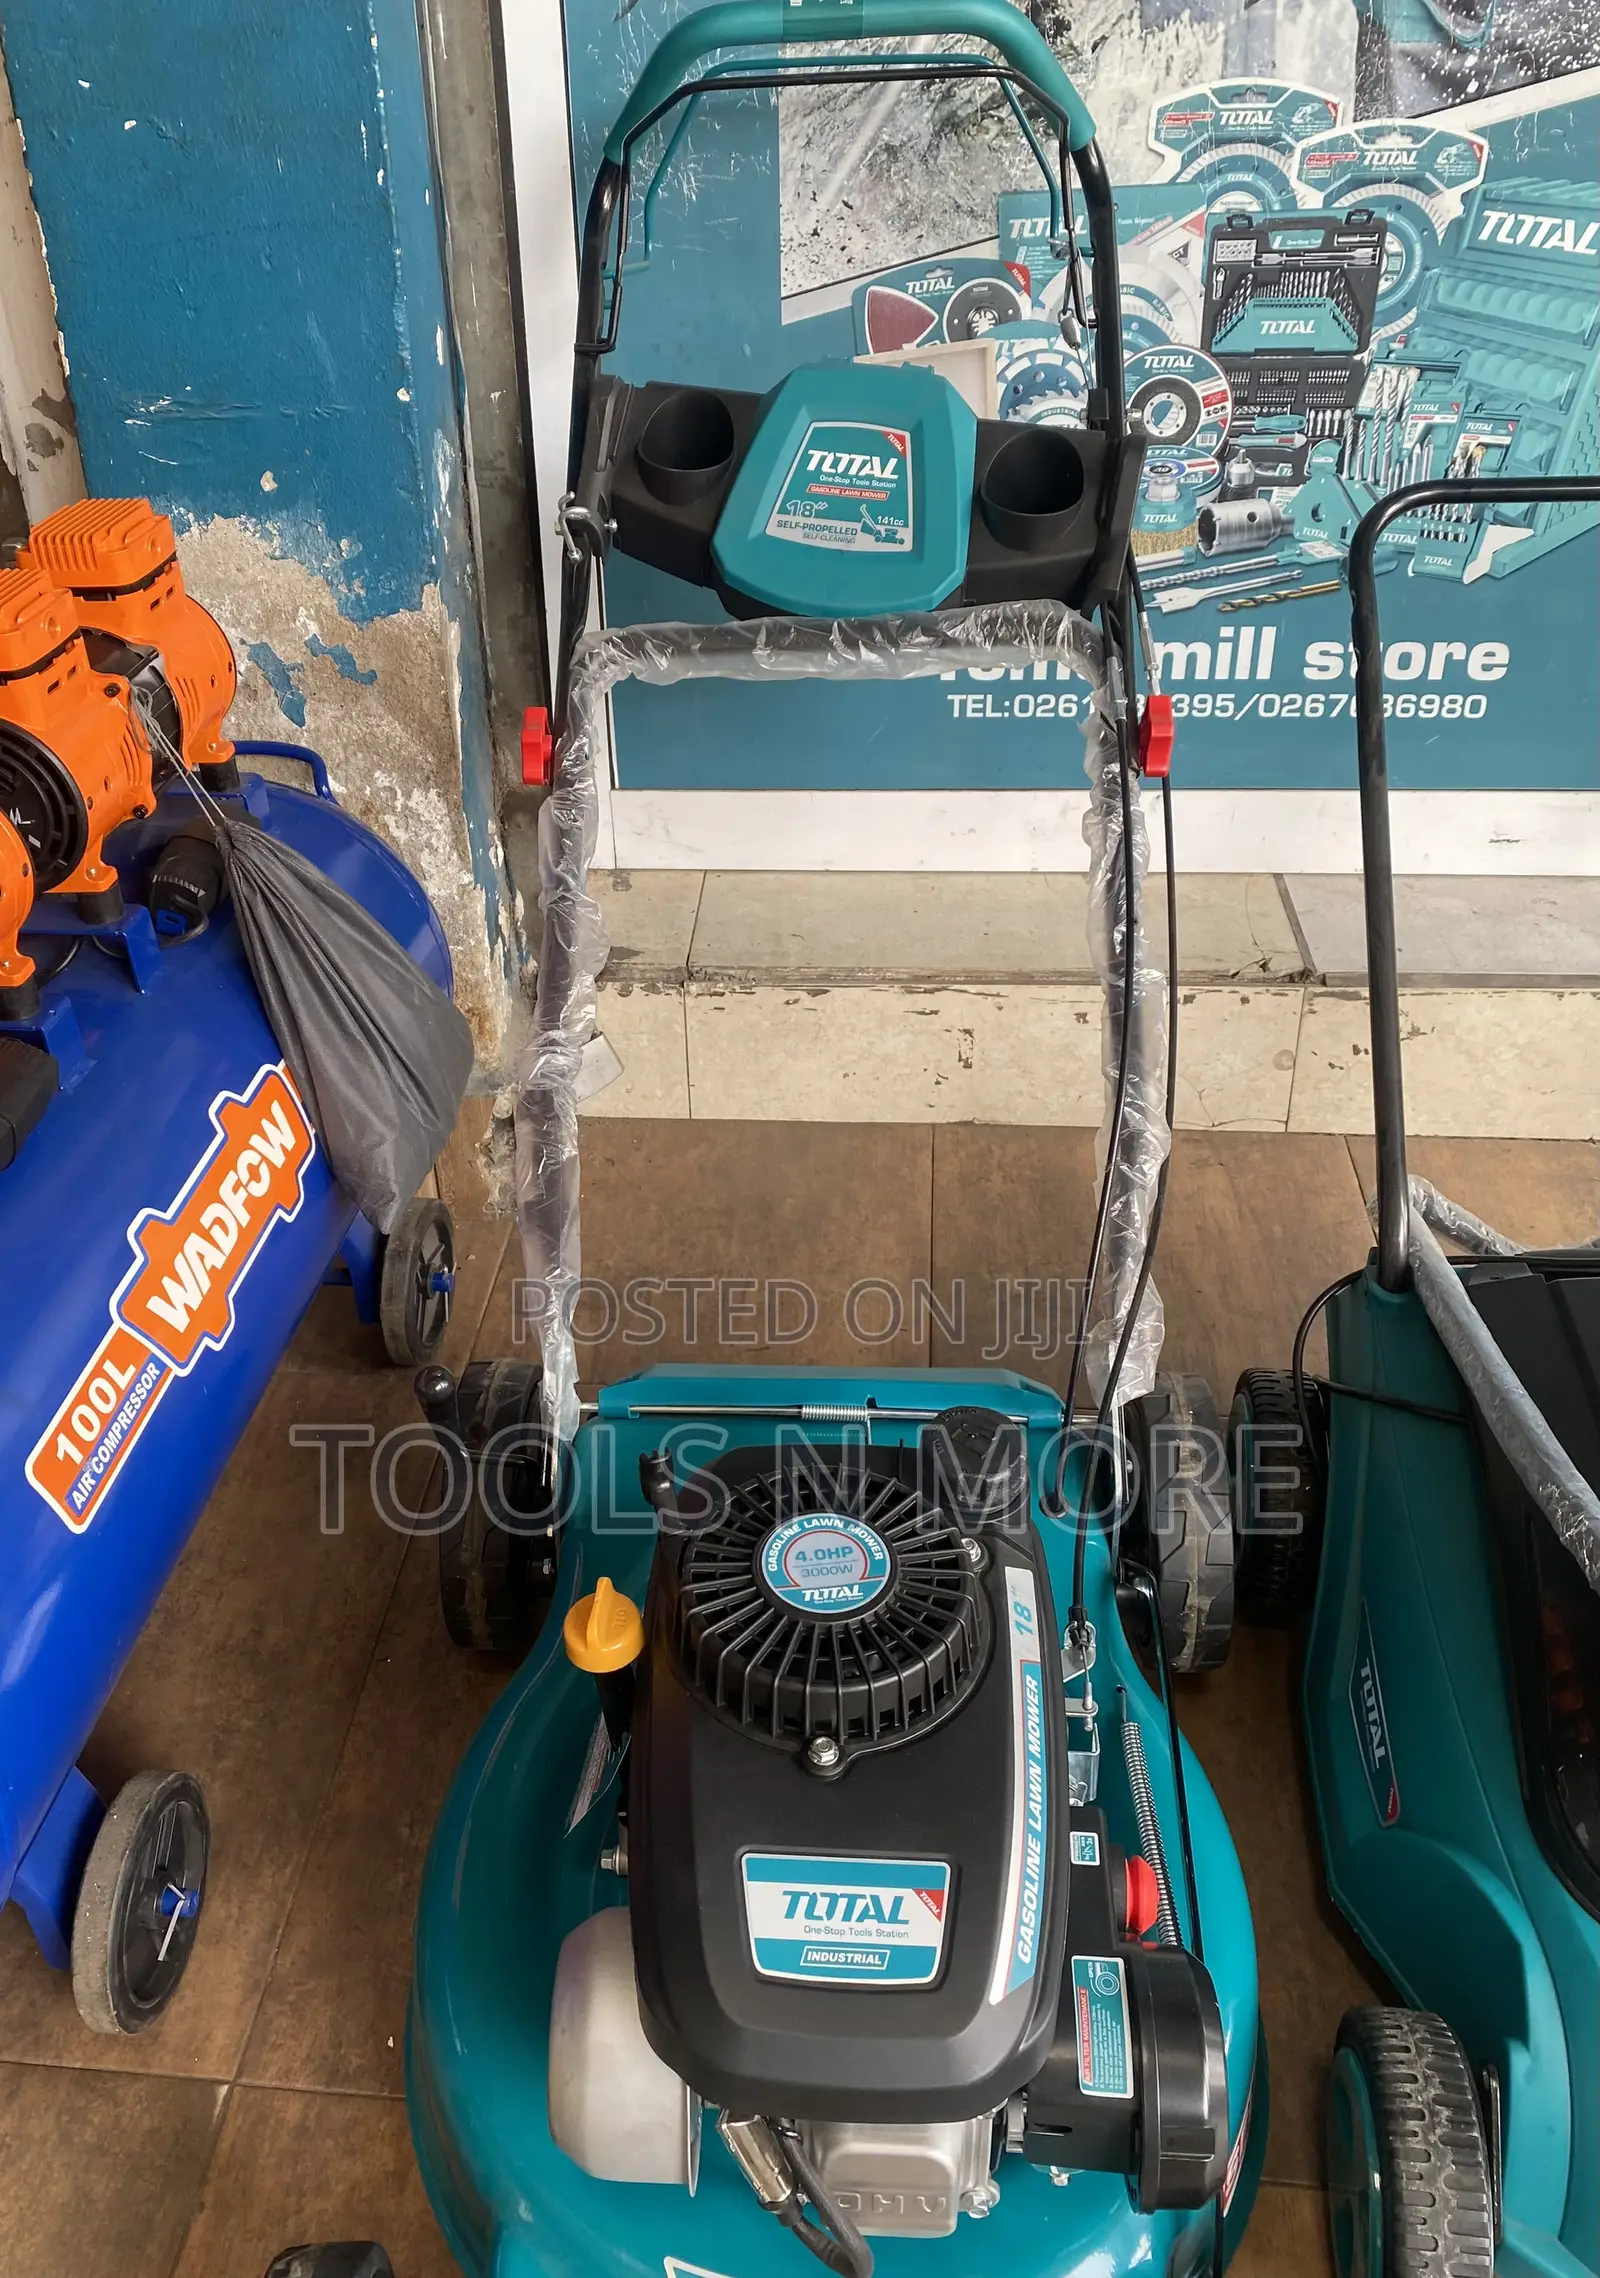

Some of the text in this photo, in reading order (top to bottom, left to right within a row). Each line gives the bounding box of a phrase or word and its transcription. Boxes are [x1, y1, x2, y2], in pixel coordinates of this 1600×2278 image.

[1220, 110, 1274, 125] TOTAL
[1363, 151, 1418, 165] TOTAL
[1478, 209, 1600, 256] TOTAL
[906, 276, 955, 294] TOTAL
[1261, 320, 1315, 335] TOTAL
[1143, 355, 1195, 369] TOTAL
[1412, 403, 1440, 412] TOTAL
[1465, 422, 1493, 431] TOTAL
[887, 433, 905, 453] TOTAL
[806, 449, 900, 479] TOTAL
[819, 474, 897, 488] One-Stop Tools Station
[810, 486, 887, 499] GASOLINE LAWN MOWER
[876, 515, 904, 526] 141cc
[1143, 513, 1178, 524] TOTAL
[776, 519, 858, 536] SELF-PROPELLED
[1302, 527, 1329, 540] TOTAL
[802, 532, 856, 544] SELF-CLEANING
[1383, 532, 1418, 545] TOTAL
[1424, 555, 1453, 566] TOTAL
[146, 1099, 296, 1334] WADFOW
[56, 1358, 136, 1467] 100L
[71, 1362, 161, 1511] AIR COMPRESSOR
[768, 1518, 884, 1572] GASOLINE LAWN MOWER
[795, 1546, 854, 1562] 4.0HP
[801, 1564, 854, 1578] 3000W
[801, 1585, 864, 1602] TOTAL
[1360, 1657, 1386, 1769] TOTAL
[1017, 1674, 1042, 1965] GASOLINE LAWN MOWER
[782, 1890, 910, 1925] TOTAL
[918, 1890, 942, 1916] TOTAL
[803, 1924, 909, 1939] One-Stop Tools Station
[806, 1950, 882, 1965] INDUSTRIAL
[1083, 2042, 1091, 2067] FILTER
[1083, 2068, 1092, 2082] AIR
